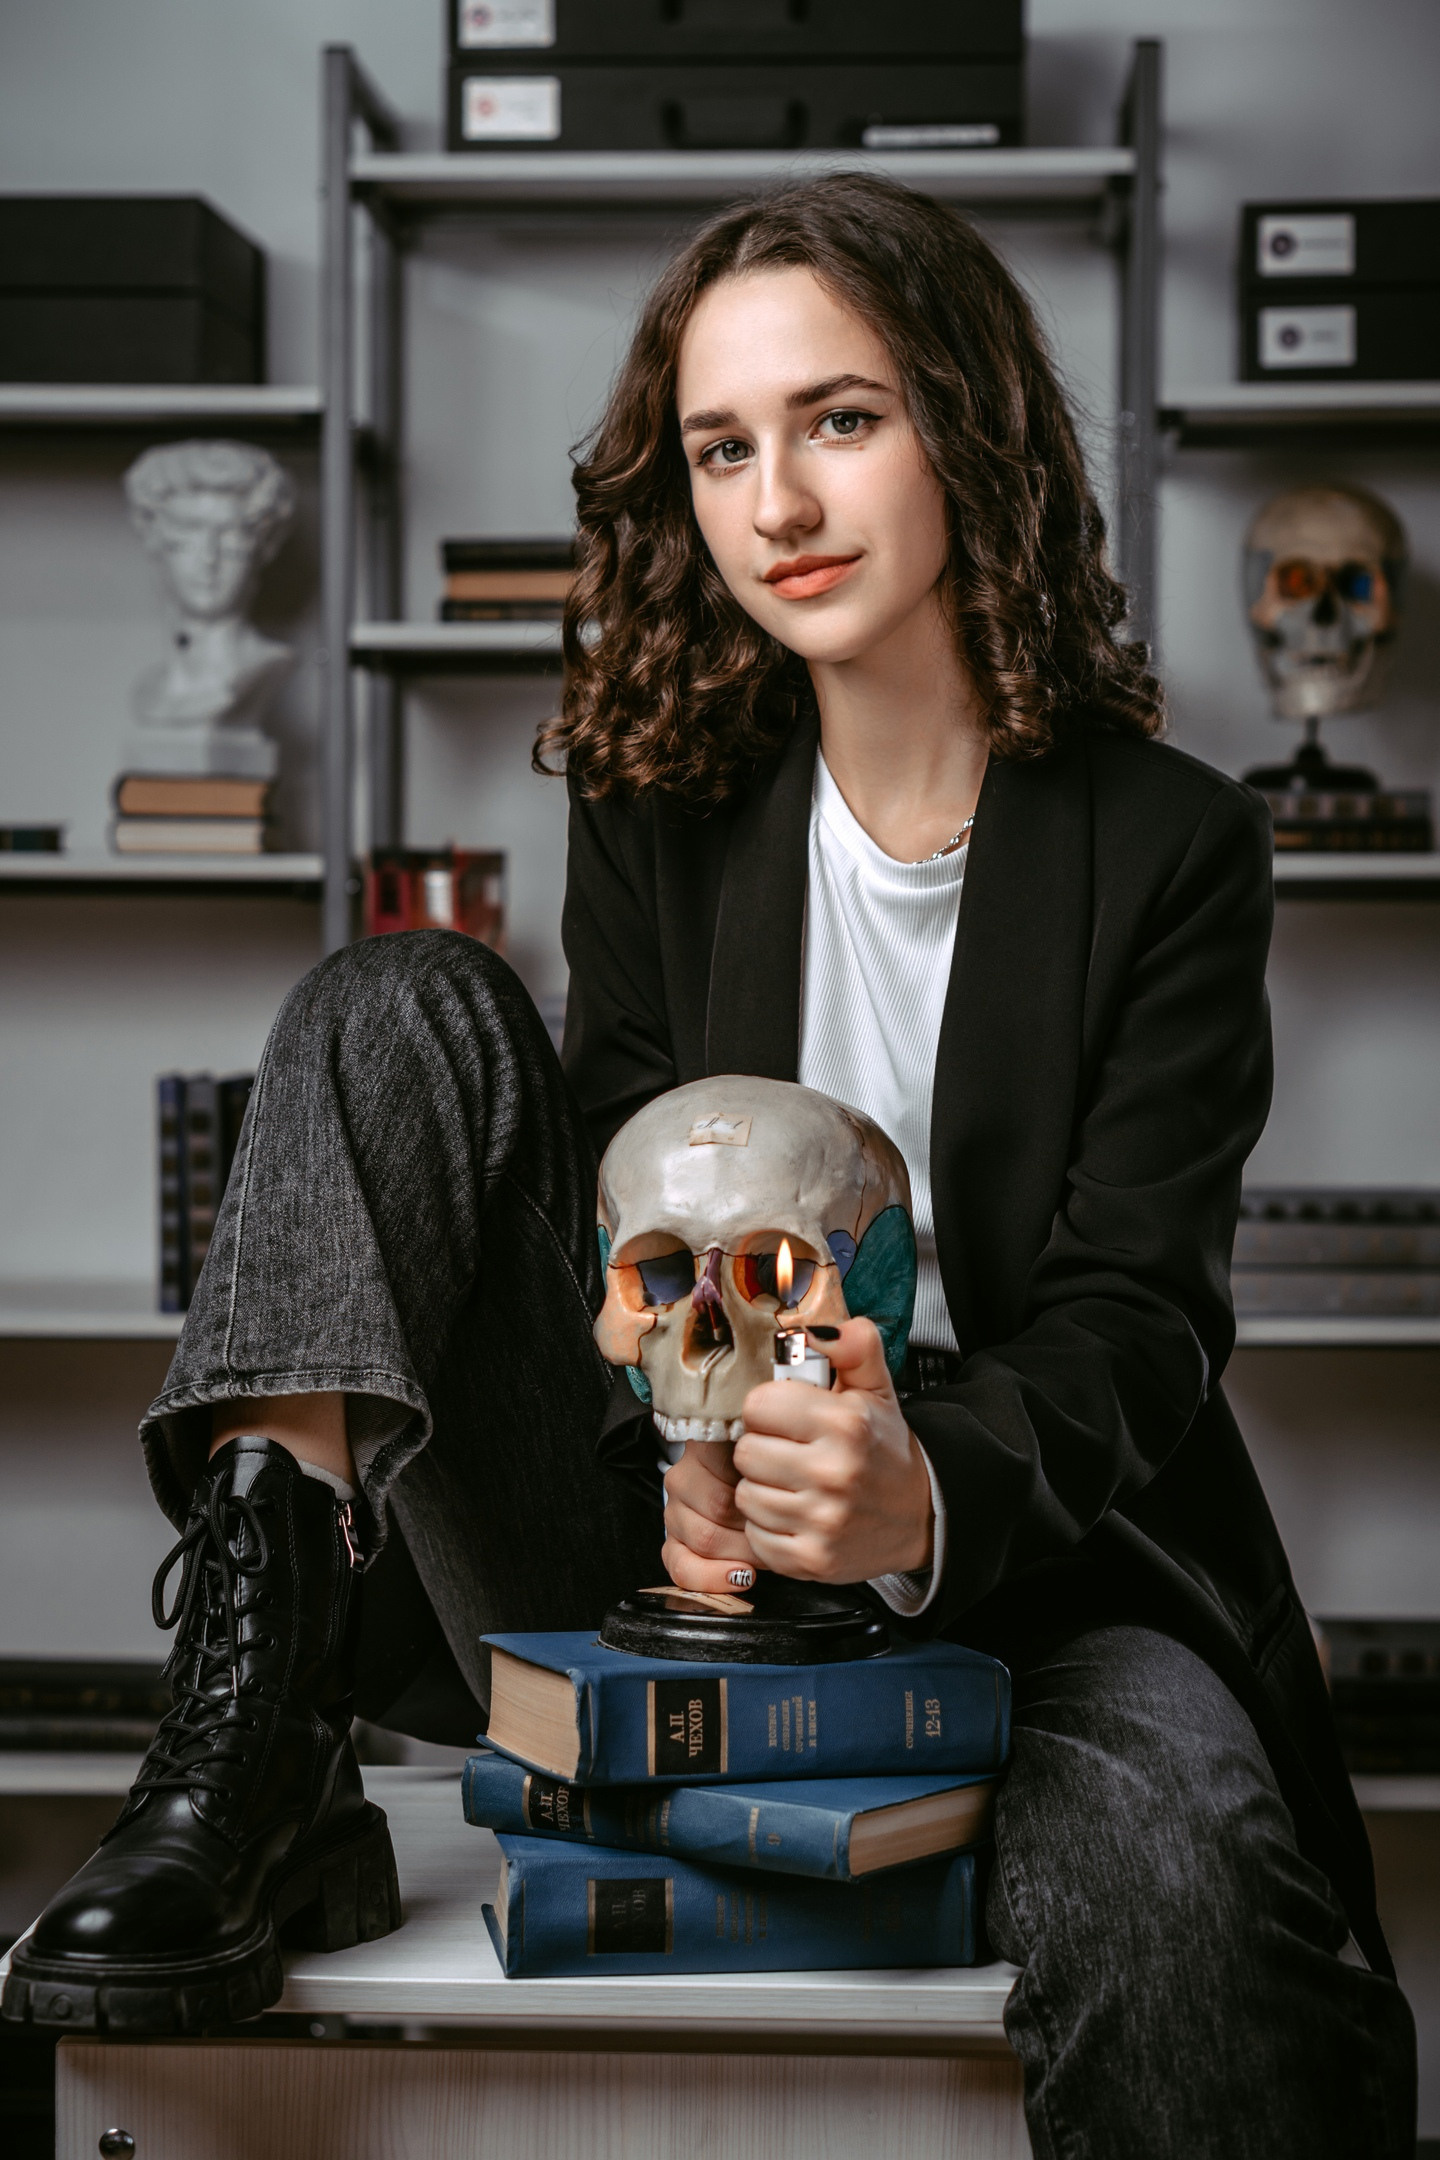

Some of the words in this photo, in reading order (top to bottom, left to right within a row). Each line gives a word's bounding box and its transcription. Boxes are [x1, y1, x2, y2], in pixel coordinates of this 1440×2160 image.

[669, 1710, 685, 1744] А.П.
[688, 1698, 703, 1758] ЧЕХОВ
[924, 1698, 941, 1738] 12-13
[539, 1791, 554, 1822] А.П.
